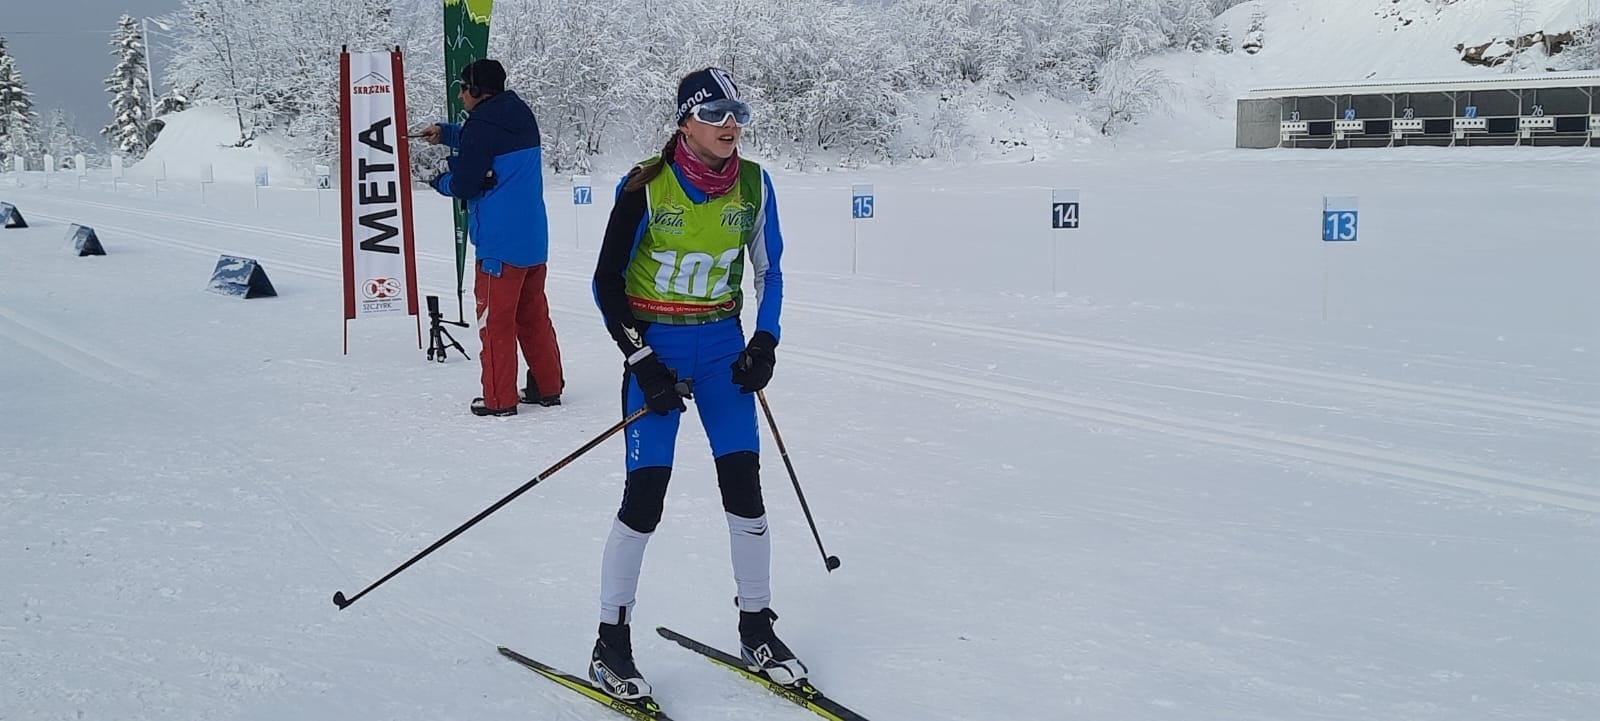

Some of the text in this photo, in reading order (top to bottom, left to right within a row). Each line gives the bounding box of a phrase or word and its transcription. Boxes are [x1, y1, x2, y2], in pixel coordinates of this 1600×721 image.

[1290, 111, 1300, 121] 30
[1344, 109, 1356, 120] 29
[1403, 108, 1414, 119] 28
[1465, 107, 1477, 118] 27
[1531, 105, 1544, 117] 26
[358, 116, 400, 255] META
[576, 188, 591, 203] 17
[855, 196, 872, 217] 15
[1053, 203, 1078, 228] 14
[1327, 212, 1356, 240] 13
